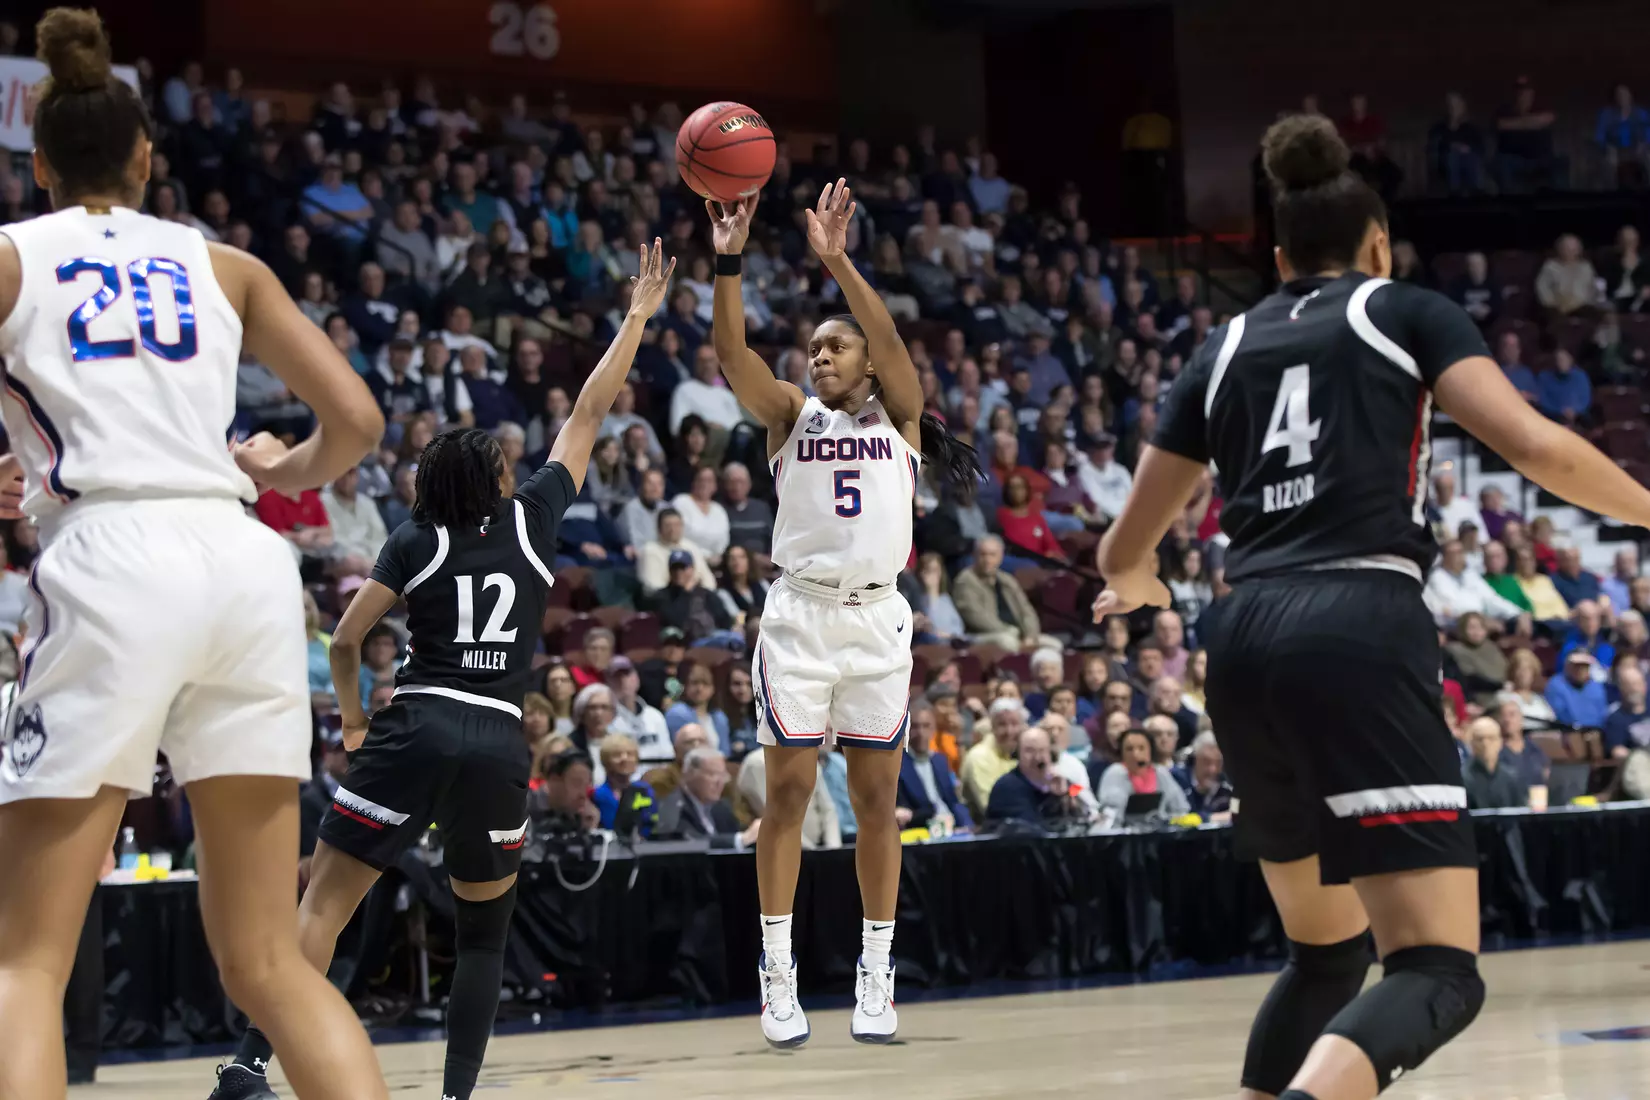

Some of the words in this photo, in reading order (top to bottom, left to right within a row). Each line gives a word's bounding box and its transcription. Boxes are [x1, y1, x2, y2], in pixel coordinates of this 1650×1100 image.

[489, 3, 560, 60] 26
[56, 256, 198, 362] 20
[1261, 363, 1322, 468] 4
[797, 437, 893, 462] UCONN
[833, 469, 862, 518] 5
[1263, 473, 1315, 513] RIZOR
[453, 572, 518, 643] 12
[461, 650, 507, 670] MILLER
